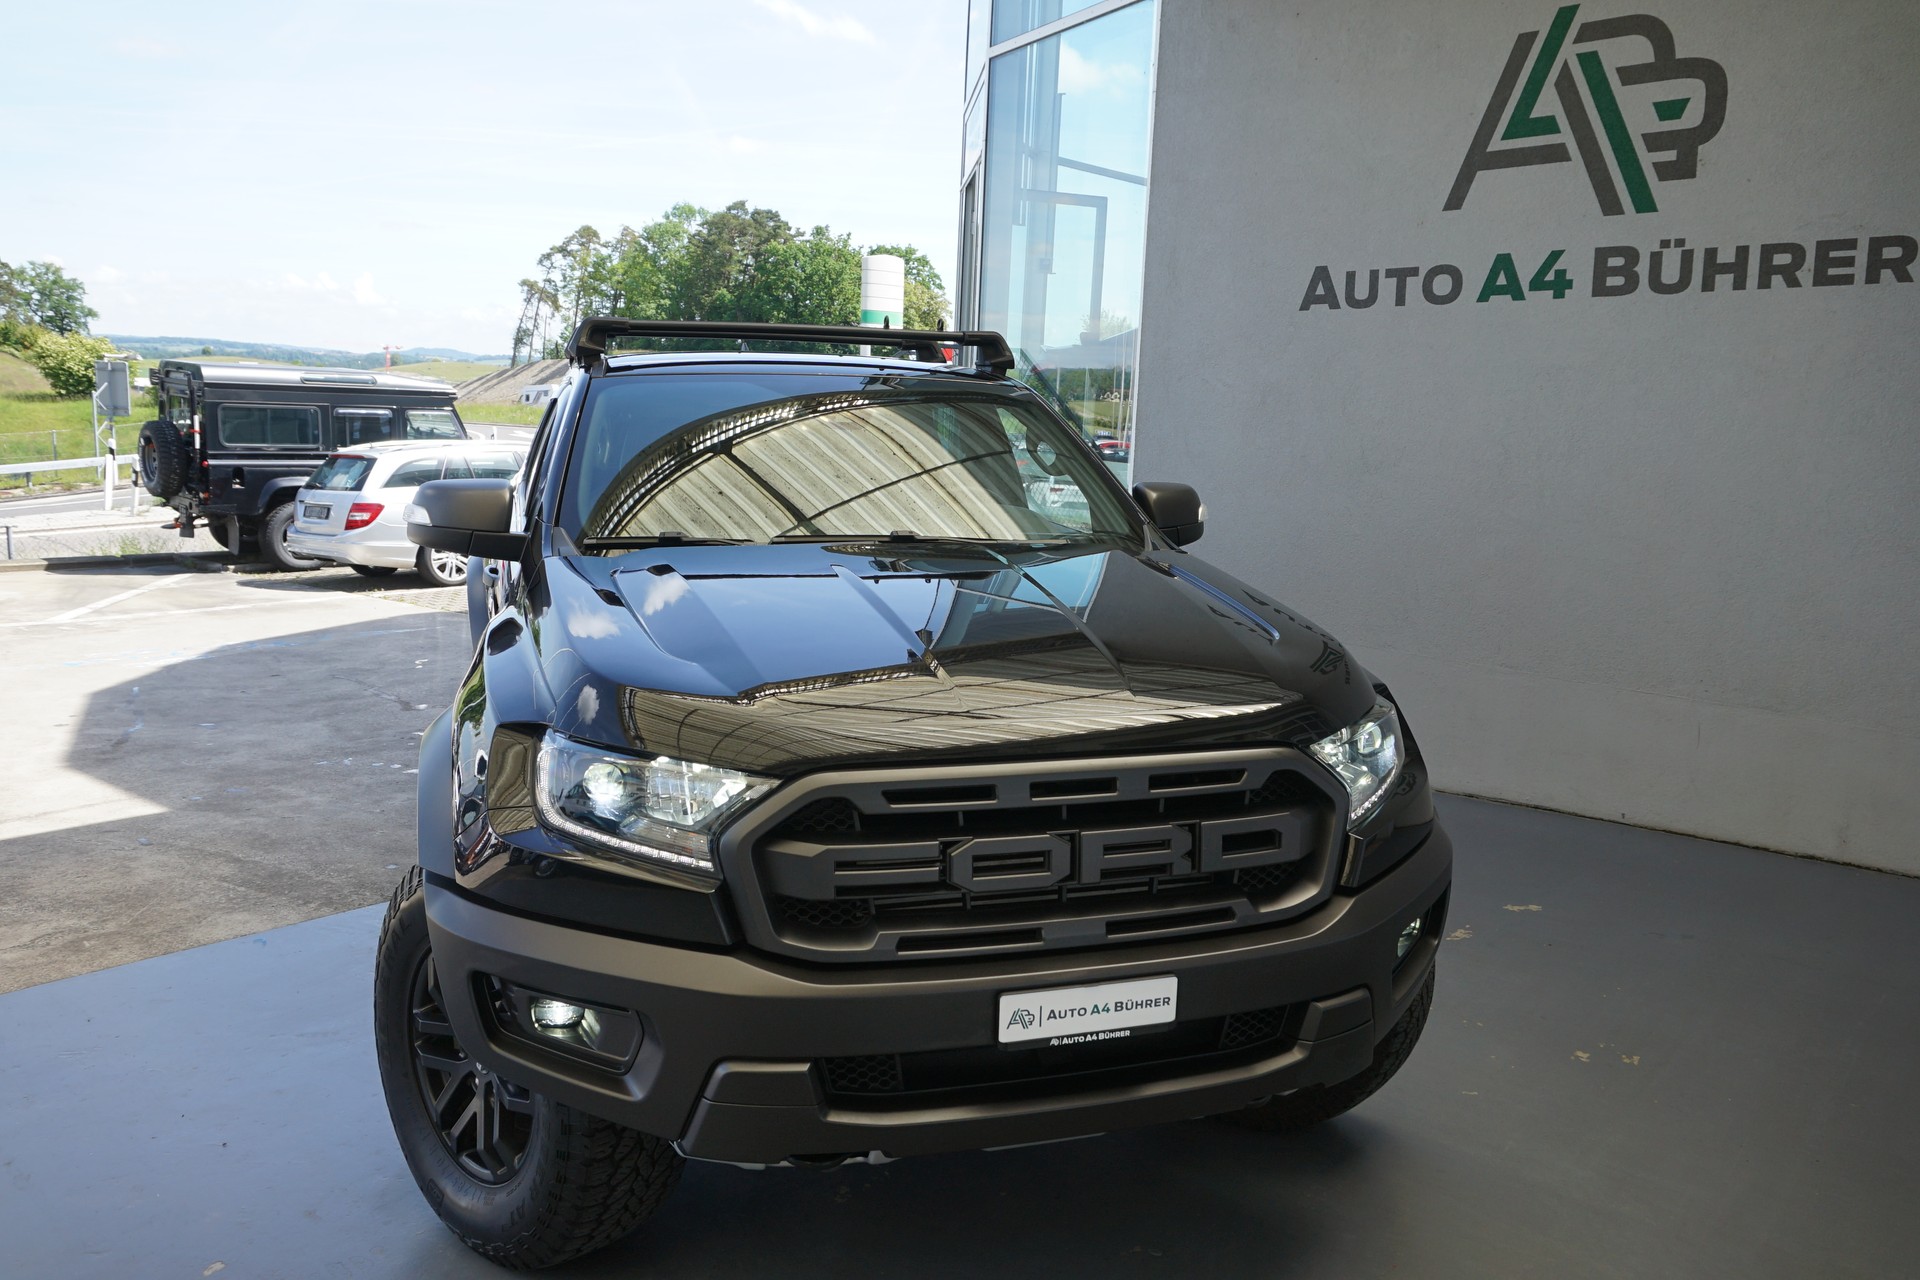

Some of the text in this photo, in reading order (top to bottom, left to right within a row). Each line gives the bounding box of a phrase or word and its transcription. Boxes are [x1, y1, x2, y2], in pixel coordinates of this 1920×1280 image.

[1299, 235, 1919, 311] AUTO A4 BÜHRER
[772, 809, 1308, 902] FORD
[1046, 1007, 1087, 1021] AUTO
[1090, 1003, 1111, 1016] A4
[1114, 996, 1171, 1012] BÜHRER
[1061, 1036, 1085, 1045] AUTO
[1085, 1033, 1098, 1042] A4
